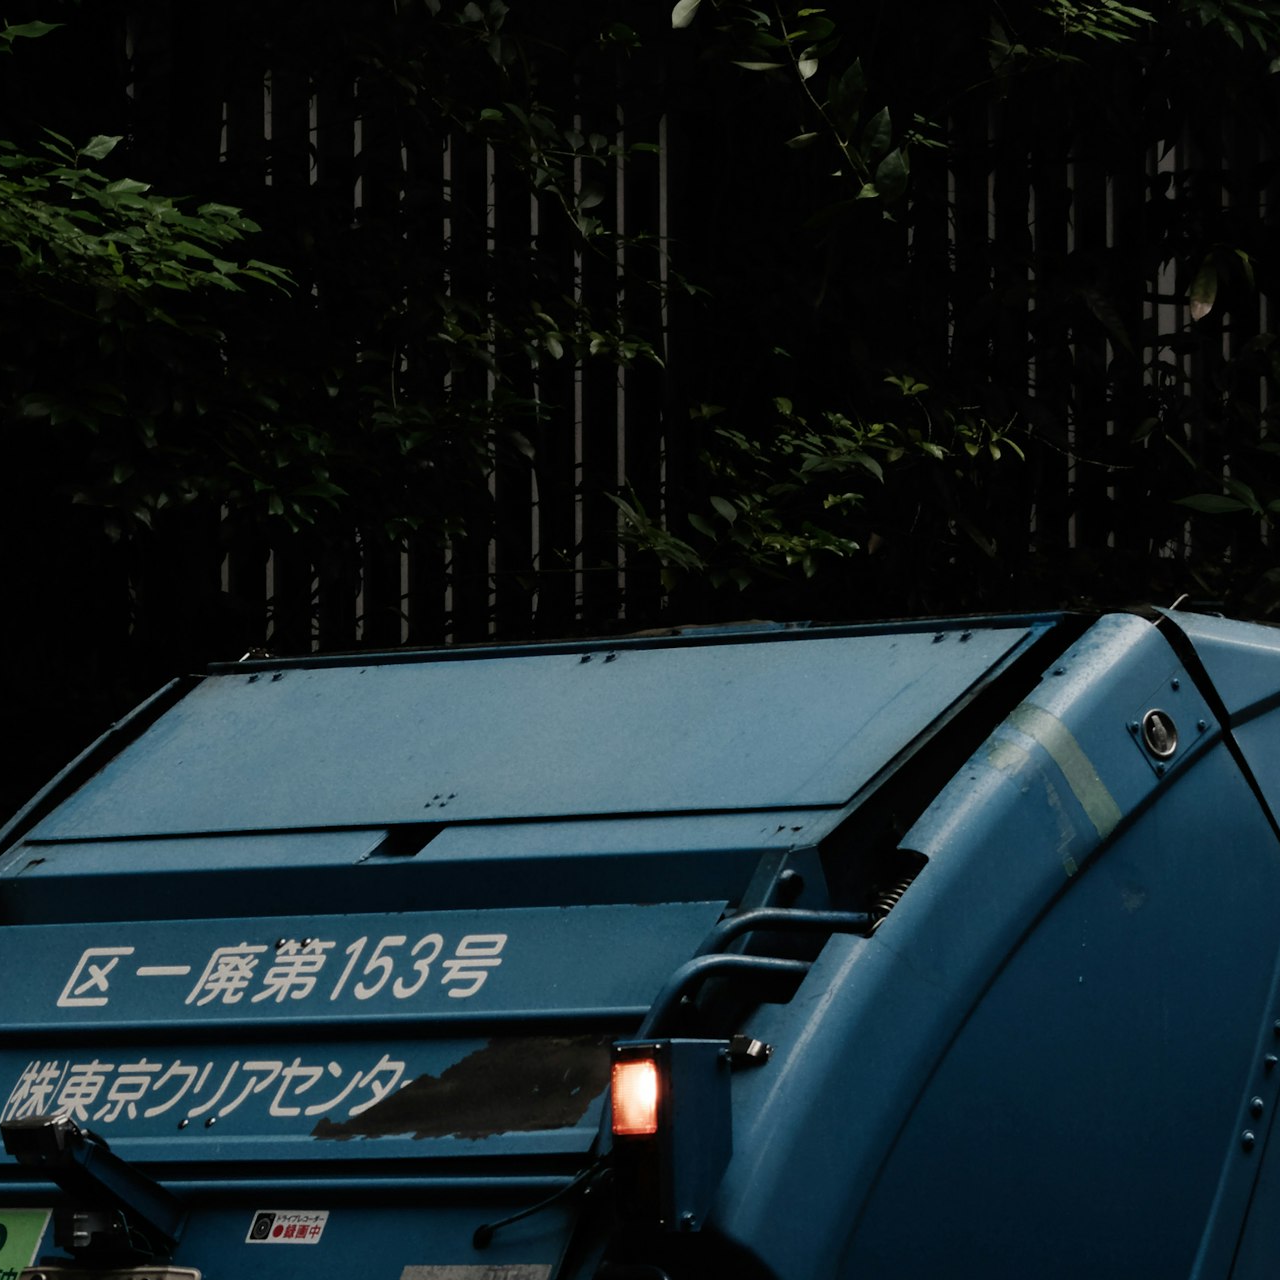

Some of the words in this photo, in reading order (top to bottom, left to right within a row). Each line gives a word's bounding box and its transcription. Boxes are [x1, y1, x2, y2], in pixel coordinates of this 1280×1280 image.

[57, 933, 508, 1007] 区一廃第153号
[0, 1054, 413, 1123] (株)東京クリアセンタ
